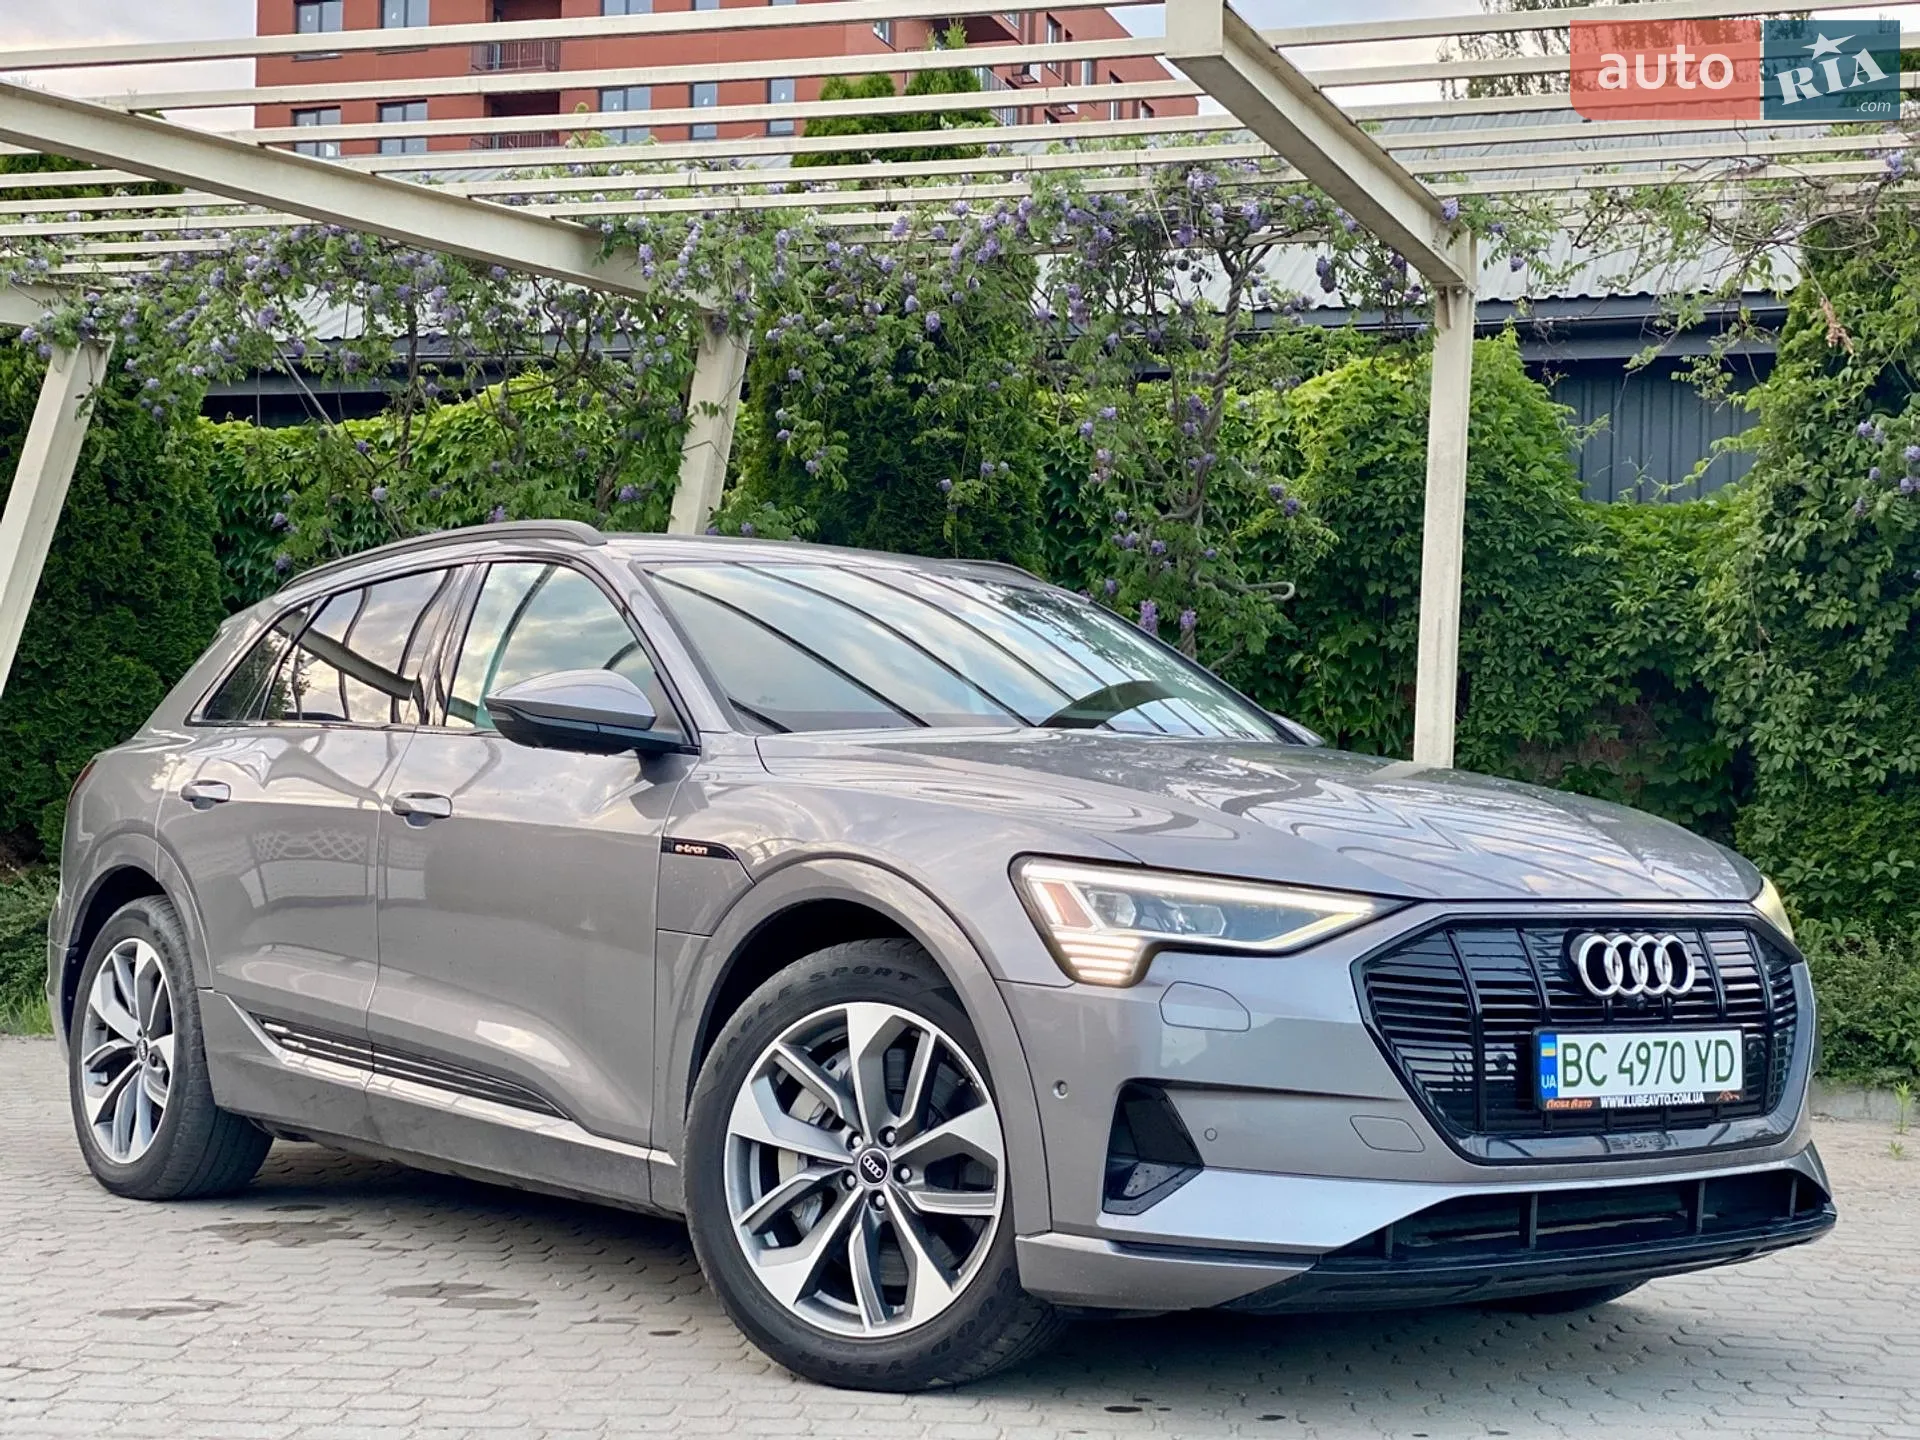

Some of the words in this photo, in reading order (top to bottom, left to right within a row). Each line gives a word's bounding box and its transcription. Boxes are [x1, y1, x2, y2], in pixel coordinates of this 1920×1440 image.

[674, 843, 708, 855] e-tron
[808, 965, 919, 983] SPORT
[1562, 1041, 1608, 1088] BC
[1617, 1040, 1686, 1086] 4970
[1694, 1039, 1735, 1083] YD
[1541, 1074, 1557, 1089] UA
